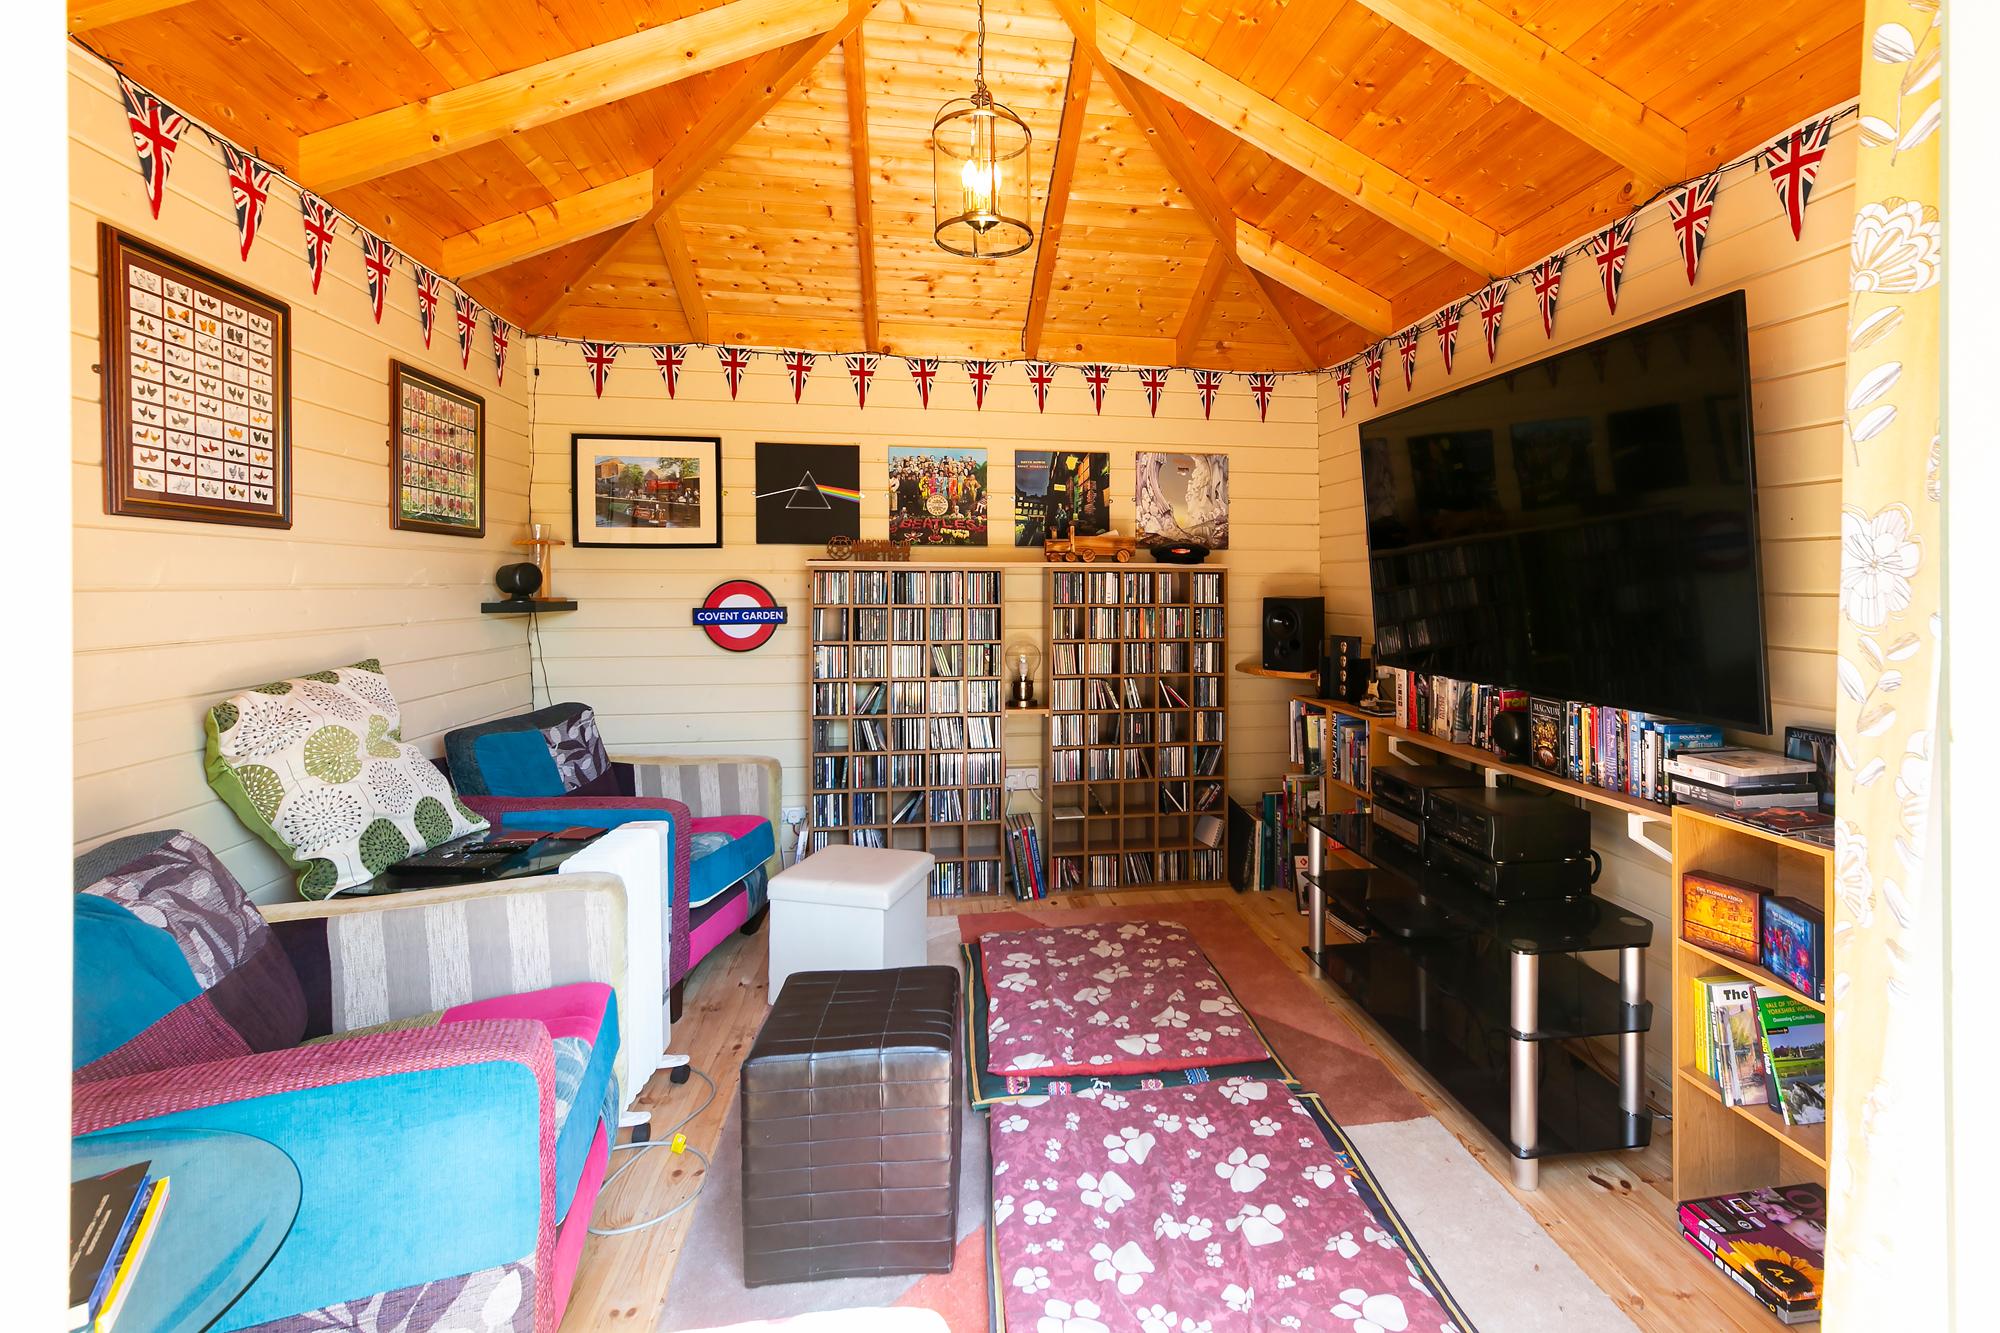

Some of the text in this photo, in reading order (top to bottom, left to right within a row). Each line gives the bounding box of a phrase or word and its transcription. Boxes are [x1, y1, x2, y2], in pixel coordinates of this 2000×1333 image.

[899, 518, 977, 531] BEATLES
[697, 611, 784, 621] COVENT GARDEN
[1533, 703, 1560, 716] MAGNUM
[1723, 989, 1749, 1001] The
[1768, 1006, 1795, 1015] YORKSHIRE
[1767, 1268, 1794, 1285] A4
